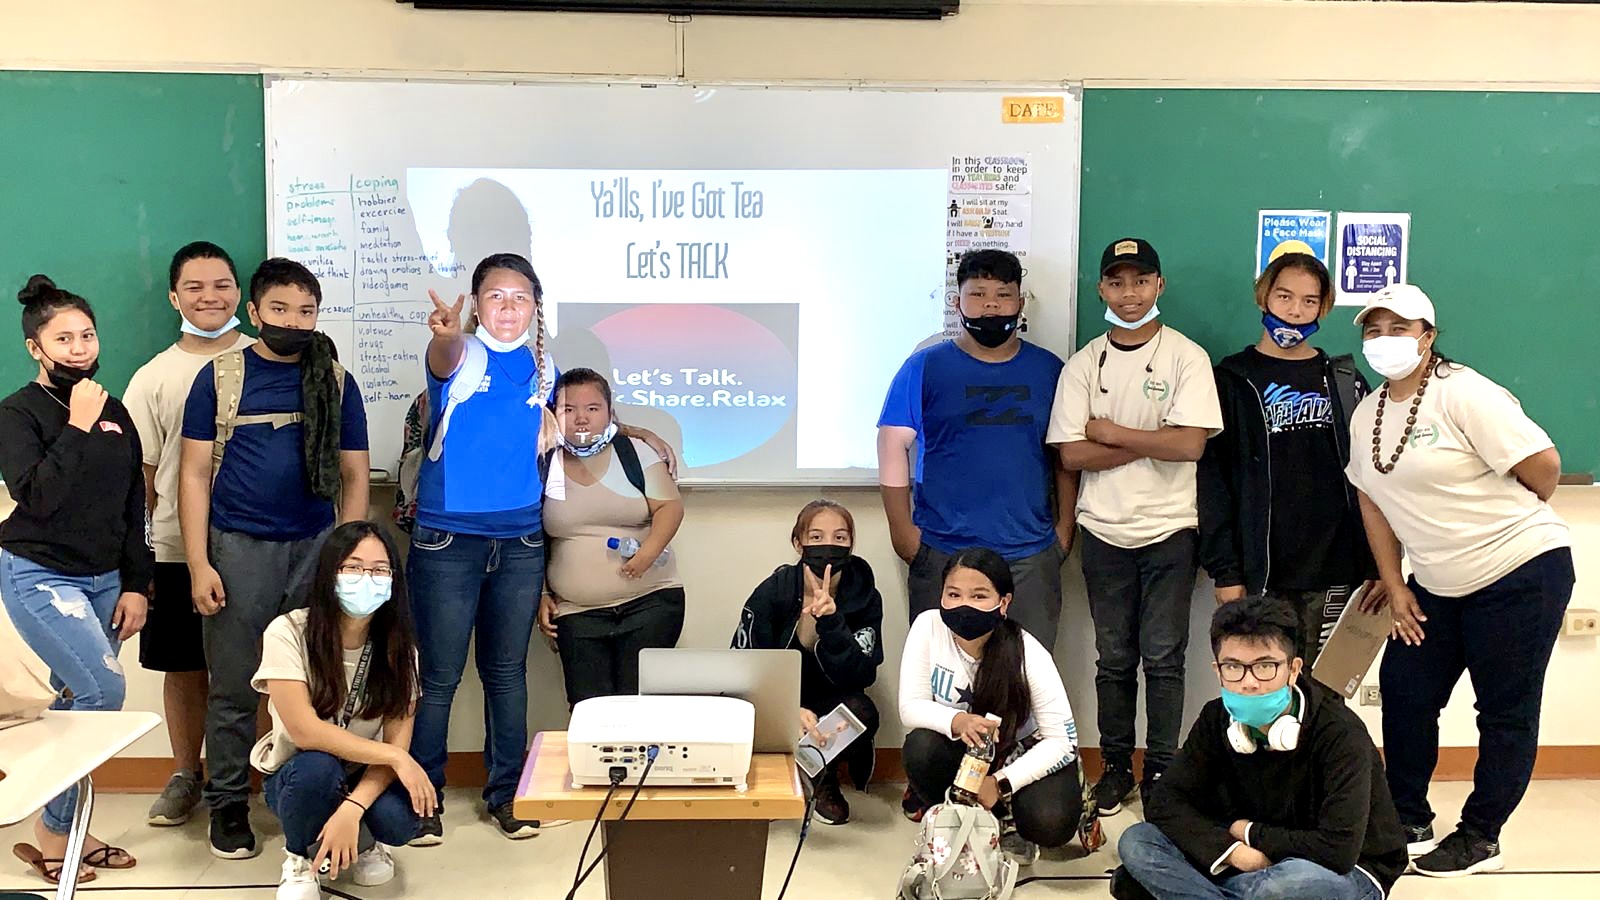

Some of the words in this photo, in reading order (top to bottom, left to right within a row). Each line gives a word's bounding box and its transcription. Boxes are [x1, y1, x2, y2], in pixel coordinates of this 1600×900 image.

[1009, 103, 1055, 117] DATE
[952, 156, 961, 165] In
[964, 156, 981, 165] this
[952, 165, 960, 173] in
[964, 165, 988, 174] order
[1006, 165, 1028, 175] keep
[356, 176, 399, 192] coping
[952, 174, 965, 184] my
[1003, 174, 1019, 182] and
[995, 182, 1017, 191] safe:
[358, 195, 397, 207] hobbies
[652, 179, 684, 219] I've
[692, 181, 725, 219] Got
[731, 181, 763, 219] Tea
[998, 200, 1008, 208] my
[992, 208, 1007, 216] Seat
[994, 221, 1004, 229] my
[1005, 220, 1023, 228] hand
[1264, 217, 1296, 228] Please
[1299, 218, 1325, 227] Wear
[360, 222, 390, 240] family
[1273, 228, 1296, 237] Face
[1299, 228, 1324, 237] Mask
[360, 238, 402, 250] meditation
[1357, 235, 1387, 246] SOCIAL
[1346, 246, 1397, 257] DISTANCING
[626, 241, 671, 279] Let's
[676, 242, 729, 279] TALK
[360, 266, 388, 281] drawing
[392, 263, 421, 276] emotions
[362, 278, 409, 296] videogames
[358, 306, 404, 323] unhealthy
[358, 325, 393, 337] violence
[358, 338, 384, 351] drugs
[360, 352, 418, 365] stress-eating
[612, 368, 673, 386] Let's
[680, 368, 743, 386] Talk.
[363, 377, 398, 390] isolation
[363, 390, 411, 403] self-harm
[931, 666, 955, 703] ALL
